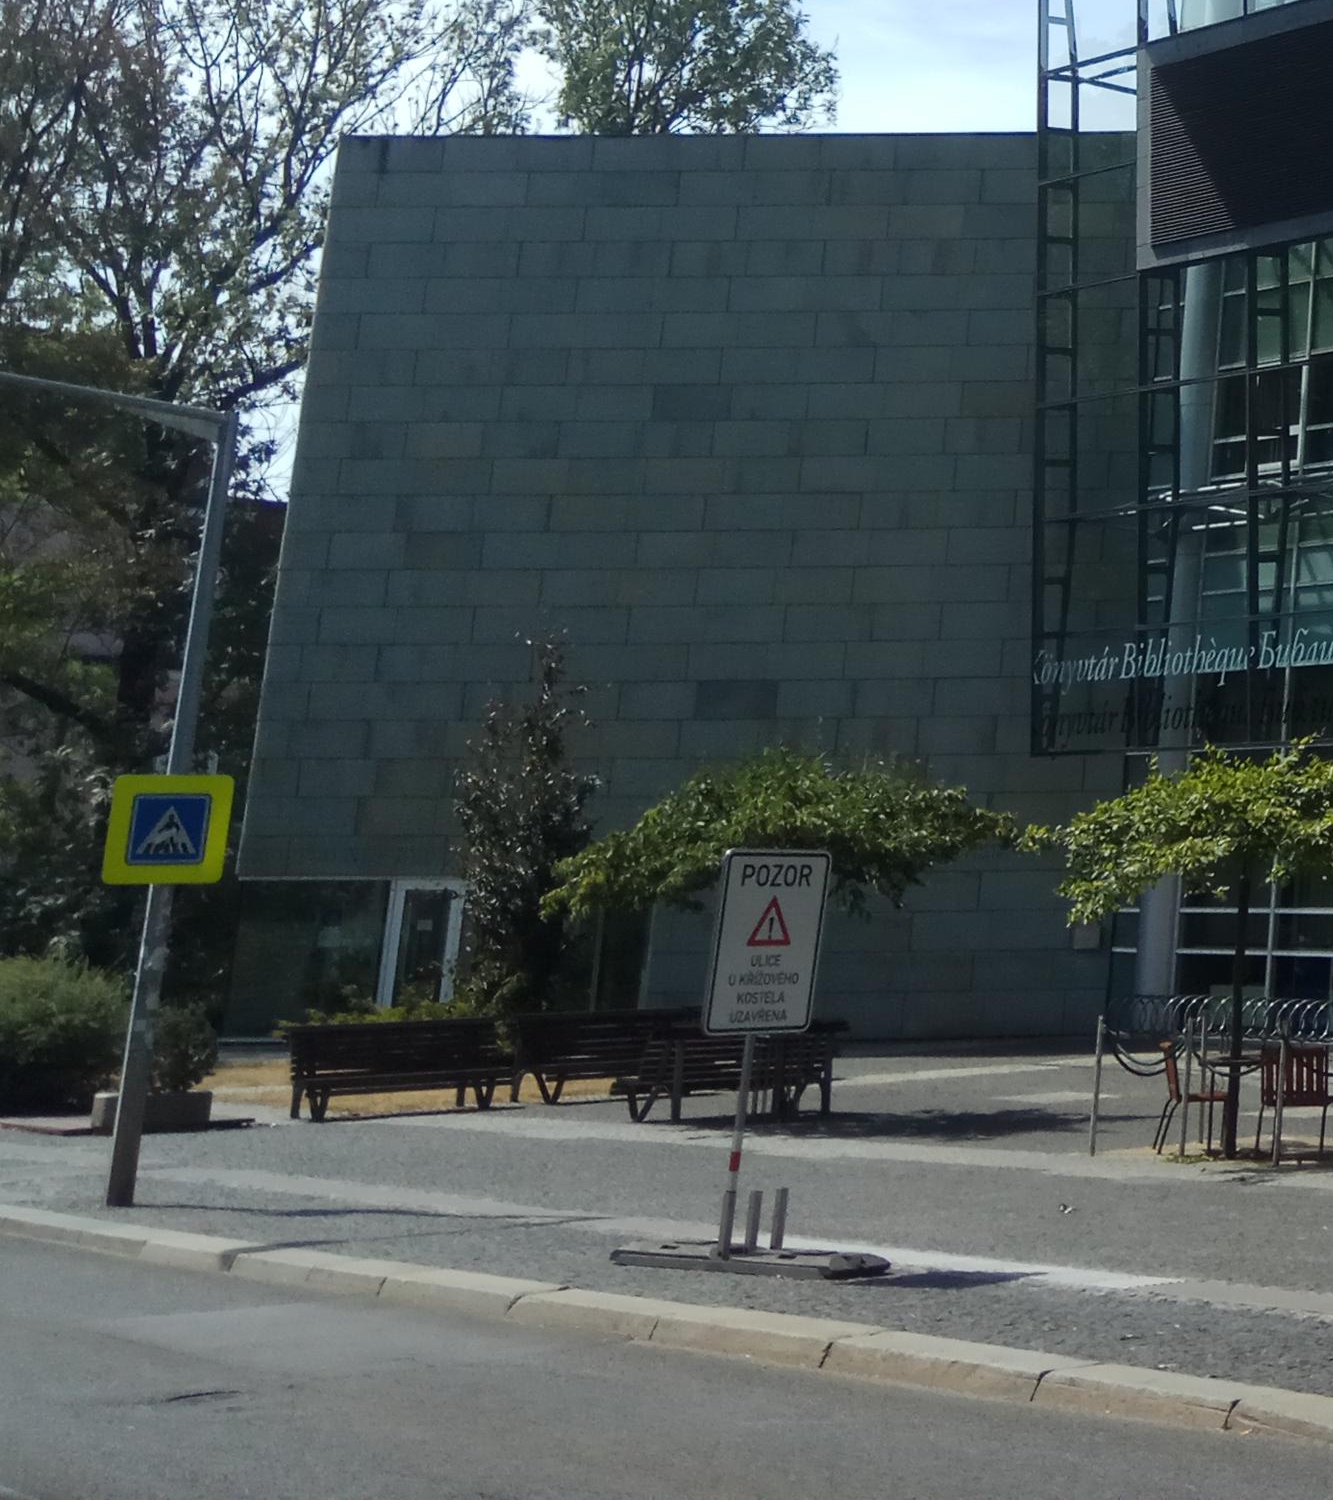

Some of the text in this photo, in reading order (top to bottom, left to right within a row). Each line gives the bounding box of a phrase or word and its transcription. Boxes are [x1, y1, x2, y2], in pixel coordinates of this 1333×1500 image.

[740, 863, 813, 888] POZOR
[750, 953, 782, 969] ULICE
[736, 990, 786, 1005] KOSTELA
